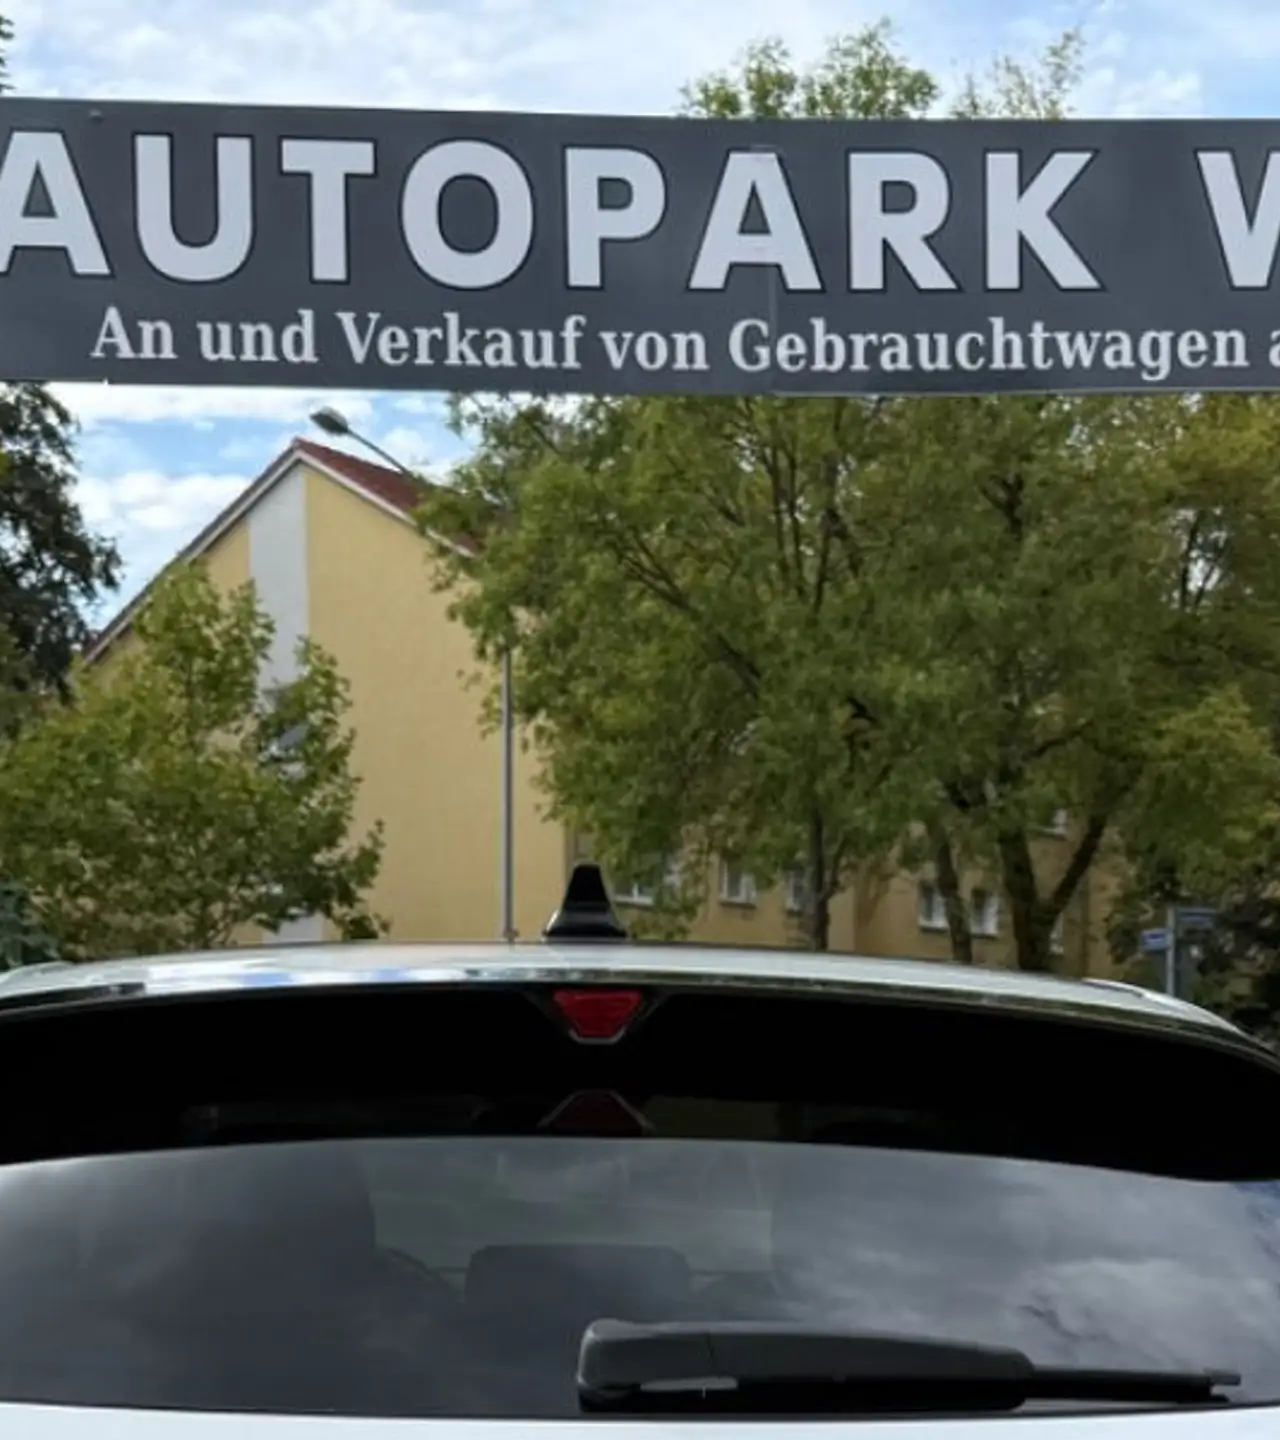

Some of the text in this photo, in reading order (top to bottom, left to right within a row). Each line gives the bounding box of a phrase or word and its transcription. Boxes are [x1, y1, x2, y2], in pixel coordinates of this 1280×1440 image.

[91, 306, 180, 361] An
[196, 308, 319, 364] und
[335, 312, 587, 370] Verkauf
[599, 331, 710, 371] von
[728, 316, 1250, 382] Gebrauchtwagen
